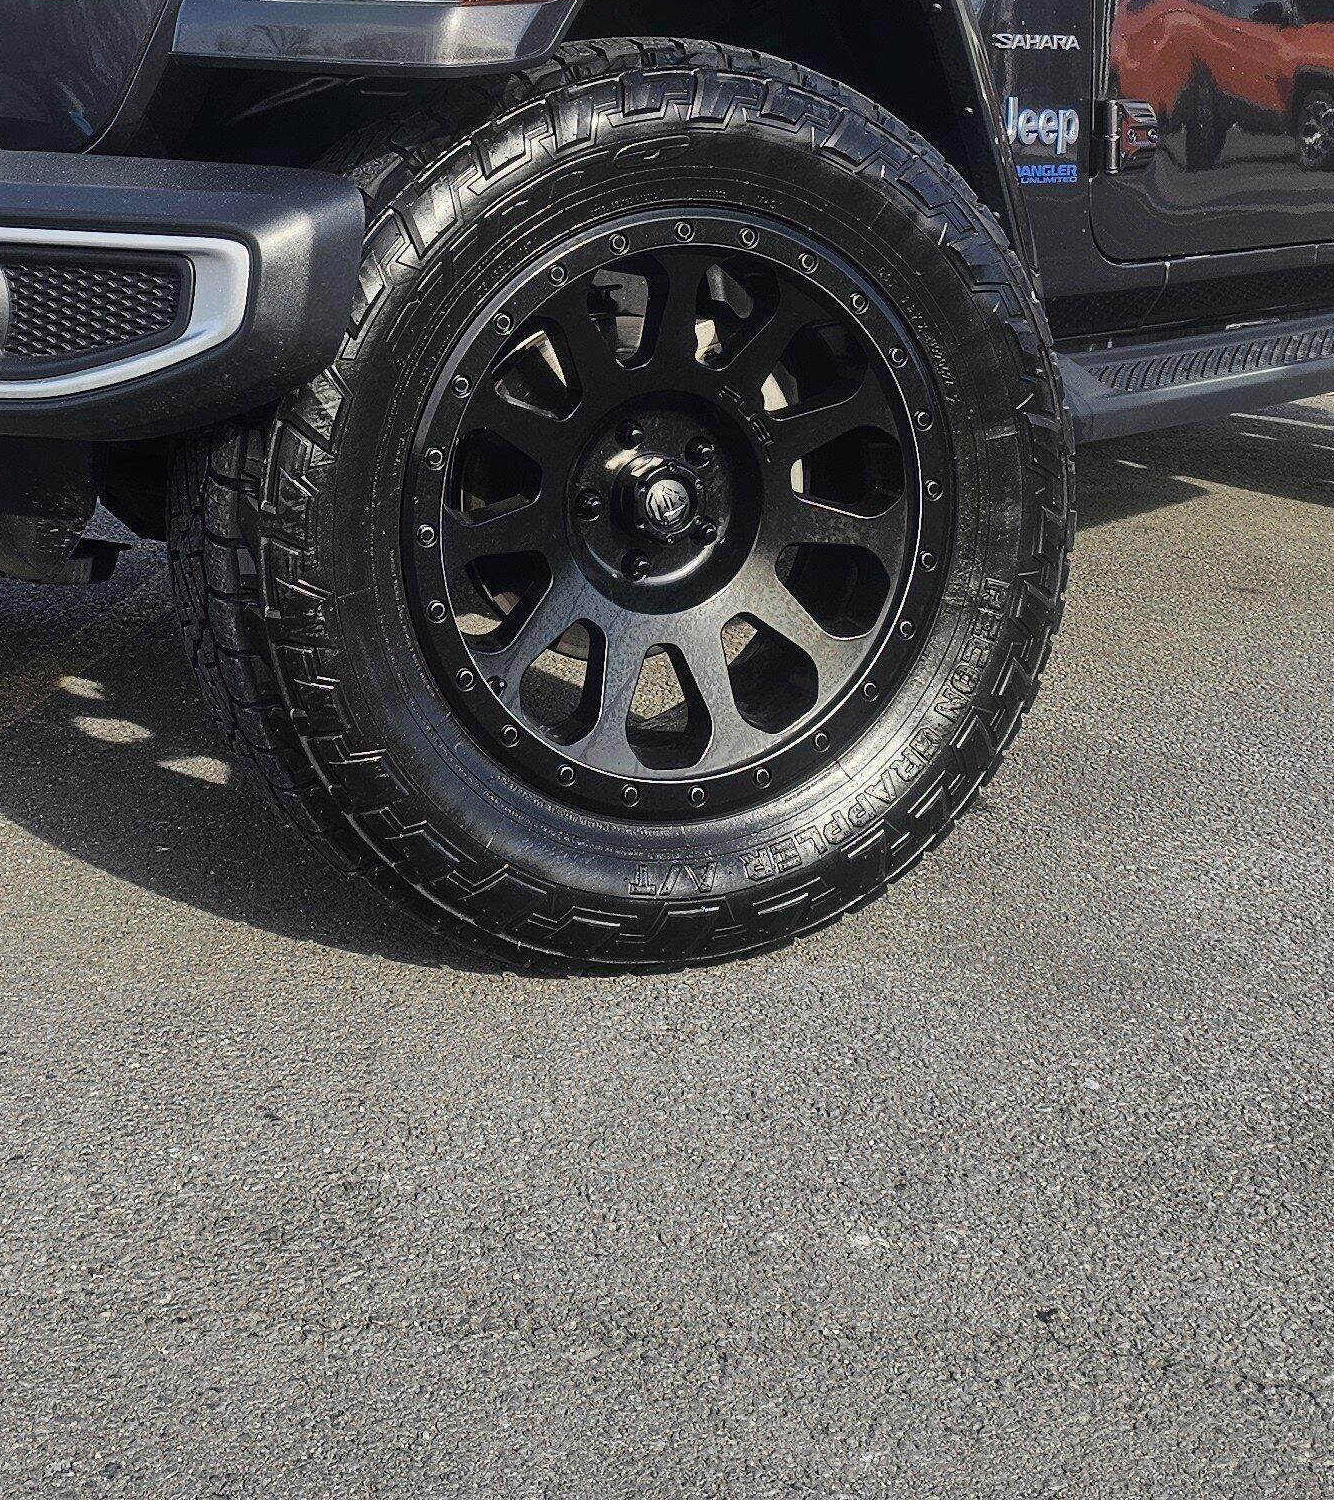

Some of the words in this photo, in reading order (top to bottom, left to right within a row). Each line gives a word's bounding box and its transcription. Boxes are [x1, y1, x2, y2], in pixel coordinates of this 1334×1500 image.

[992, 33, 1081, 50] SAHARA
[1005, 96, 1080, 155] Jeep
[1016, 164, 1077, 177] ANGLER
[1020, 176, 1077, 184] UNLIMITED
[934, 577, 1010, 720] RECON
[740, 726, 943, 883] GRAPPLER
[629, 862, 718, 897] A/T
